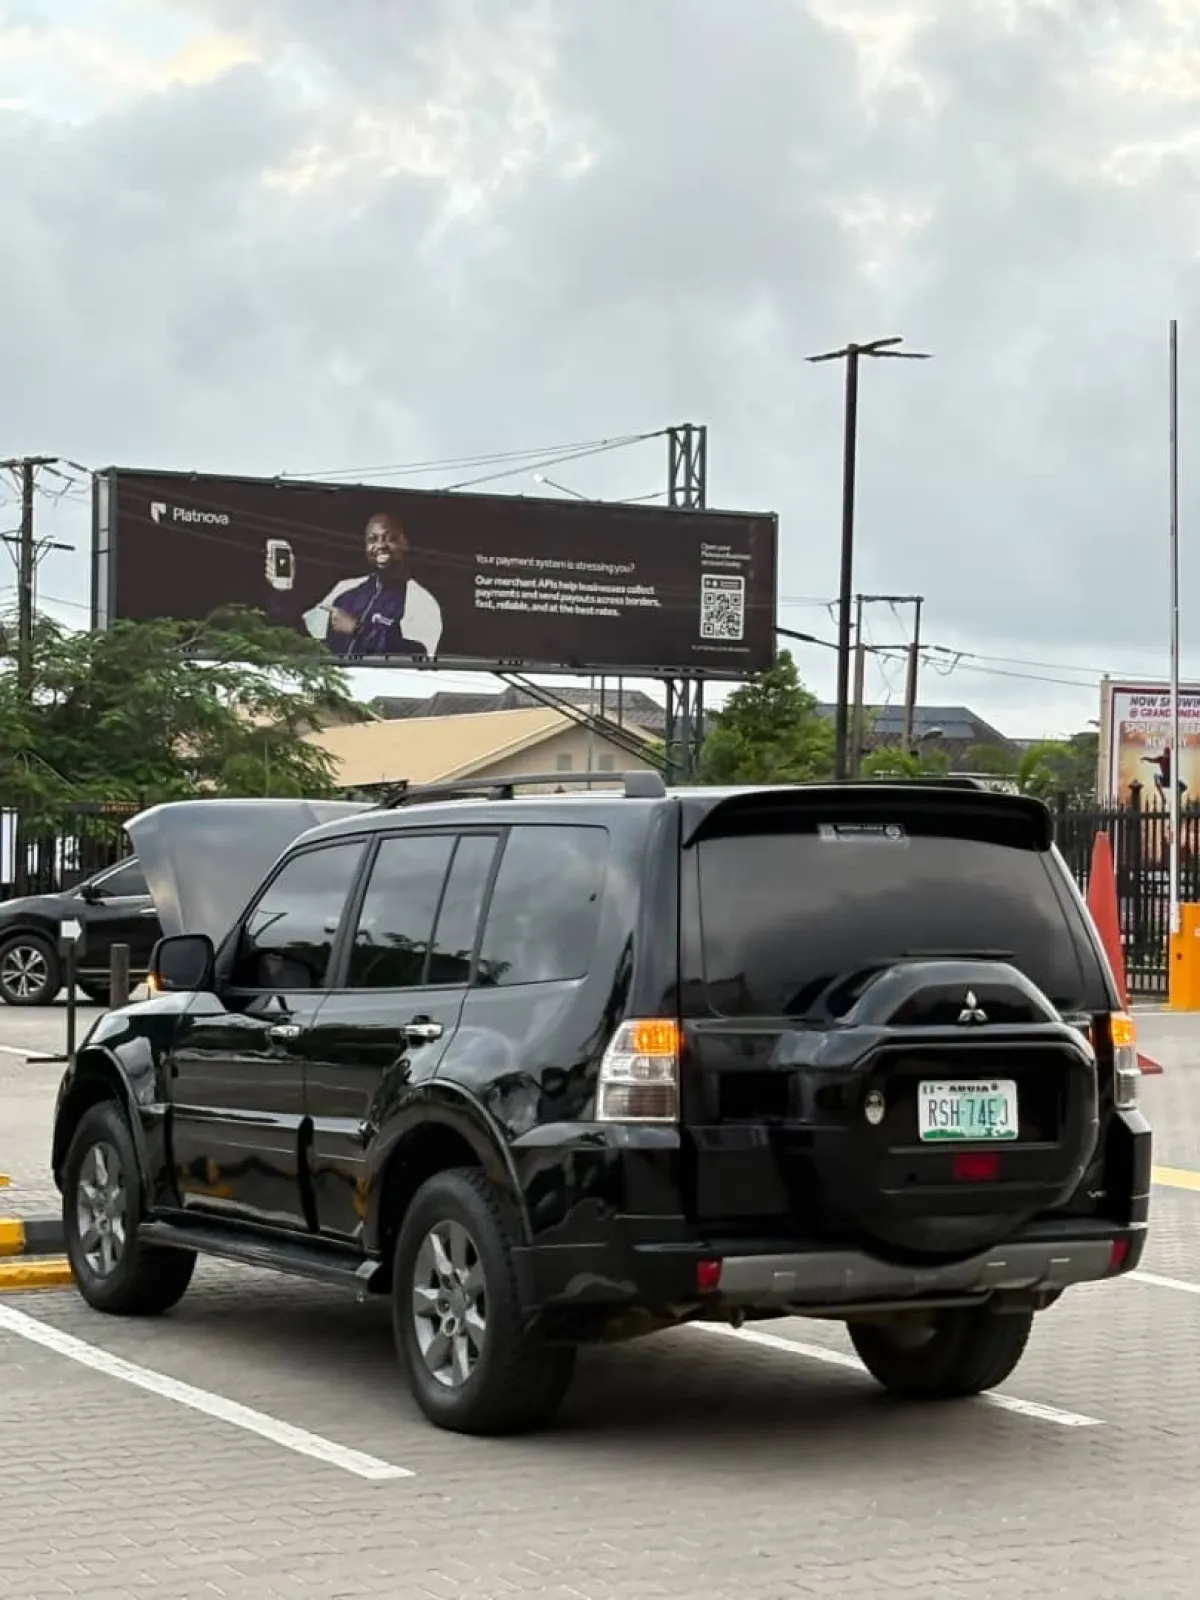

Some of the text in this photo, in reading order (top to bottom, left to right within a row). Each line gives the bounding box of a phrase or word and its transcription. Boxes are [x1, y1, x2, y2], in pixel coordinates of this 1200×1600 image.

[172, 506, 230, 527] Platnova
[474, 553, 495, 565] Your
[495, 555, 536, 568] payment
[536, 557, 566, 570] system
[575, 561, 613, 575] stressing
[613, 562, 636, 576] you?
[474, 574, 656, 596] Our merchant APIs help businesses collect
[474, 589, 520, 600] payments
[520, 589, 539, 599] and
[539, 591, 560, 601] send
[559, 593, 595, 605] payouts
[595, 595, 625, 606] across
[474, 599, 496, 612] fast,
[531, 602, 550, 613] and
[559, 603, 575, 615] the
[574, 604, 595, 616] best
[1129, 696, 1158, 707] NOW
